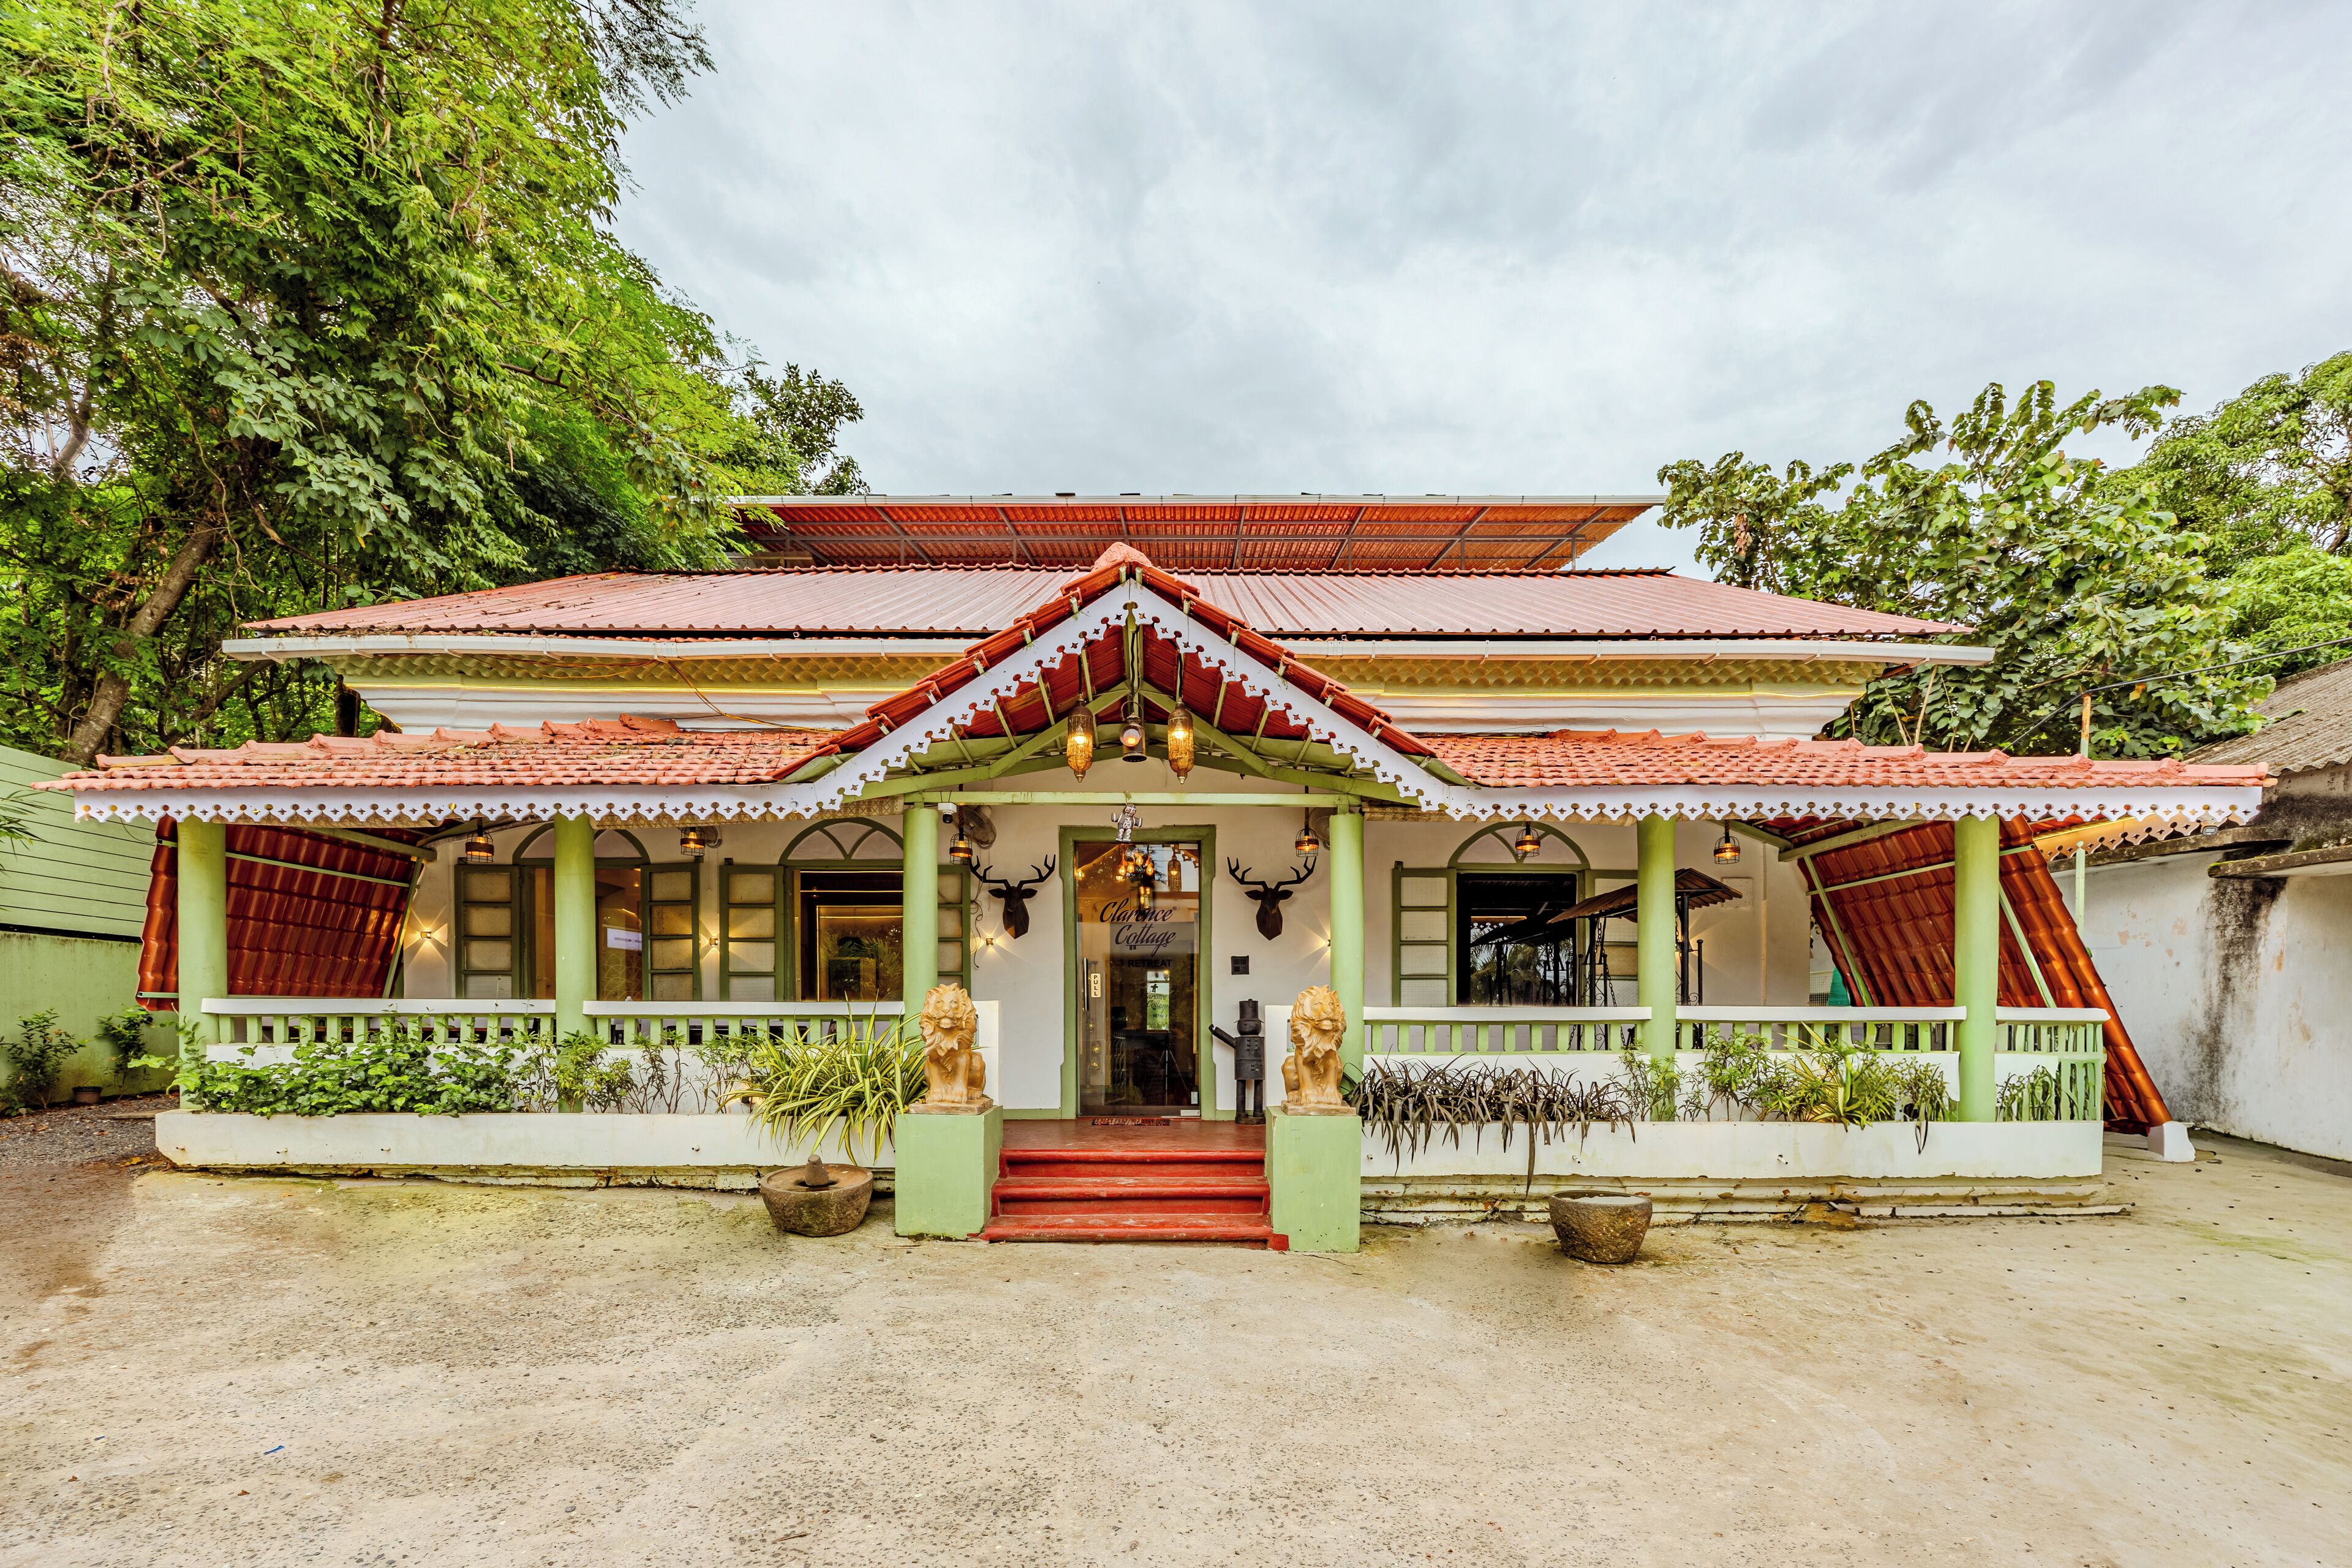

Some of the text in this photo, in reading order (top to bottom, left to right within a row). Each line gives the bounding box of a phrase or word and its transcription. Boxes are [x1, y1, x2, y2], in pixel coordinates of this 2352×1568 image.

[1100, 898, 1173, 922] Clarence
[1115, 923, 1176, 957] Cottage
[1128, 959, 1172, 968] RETREAT
